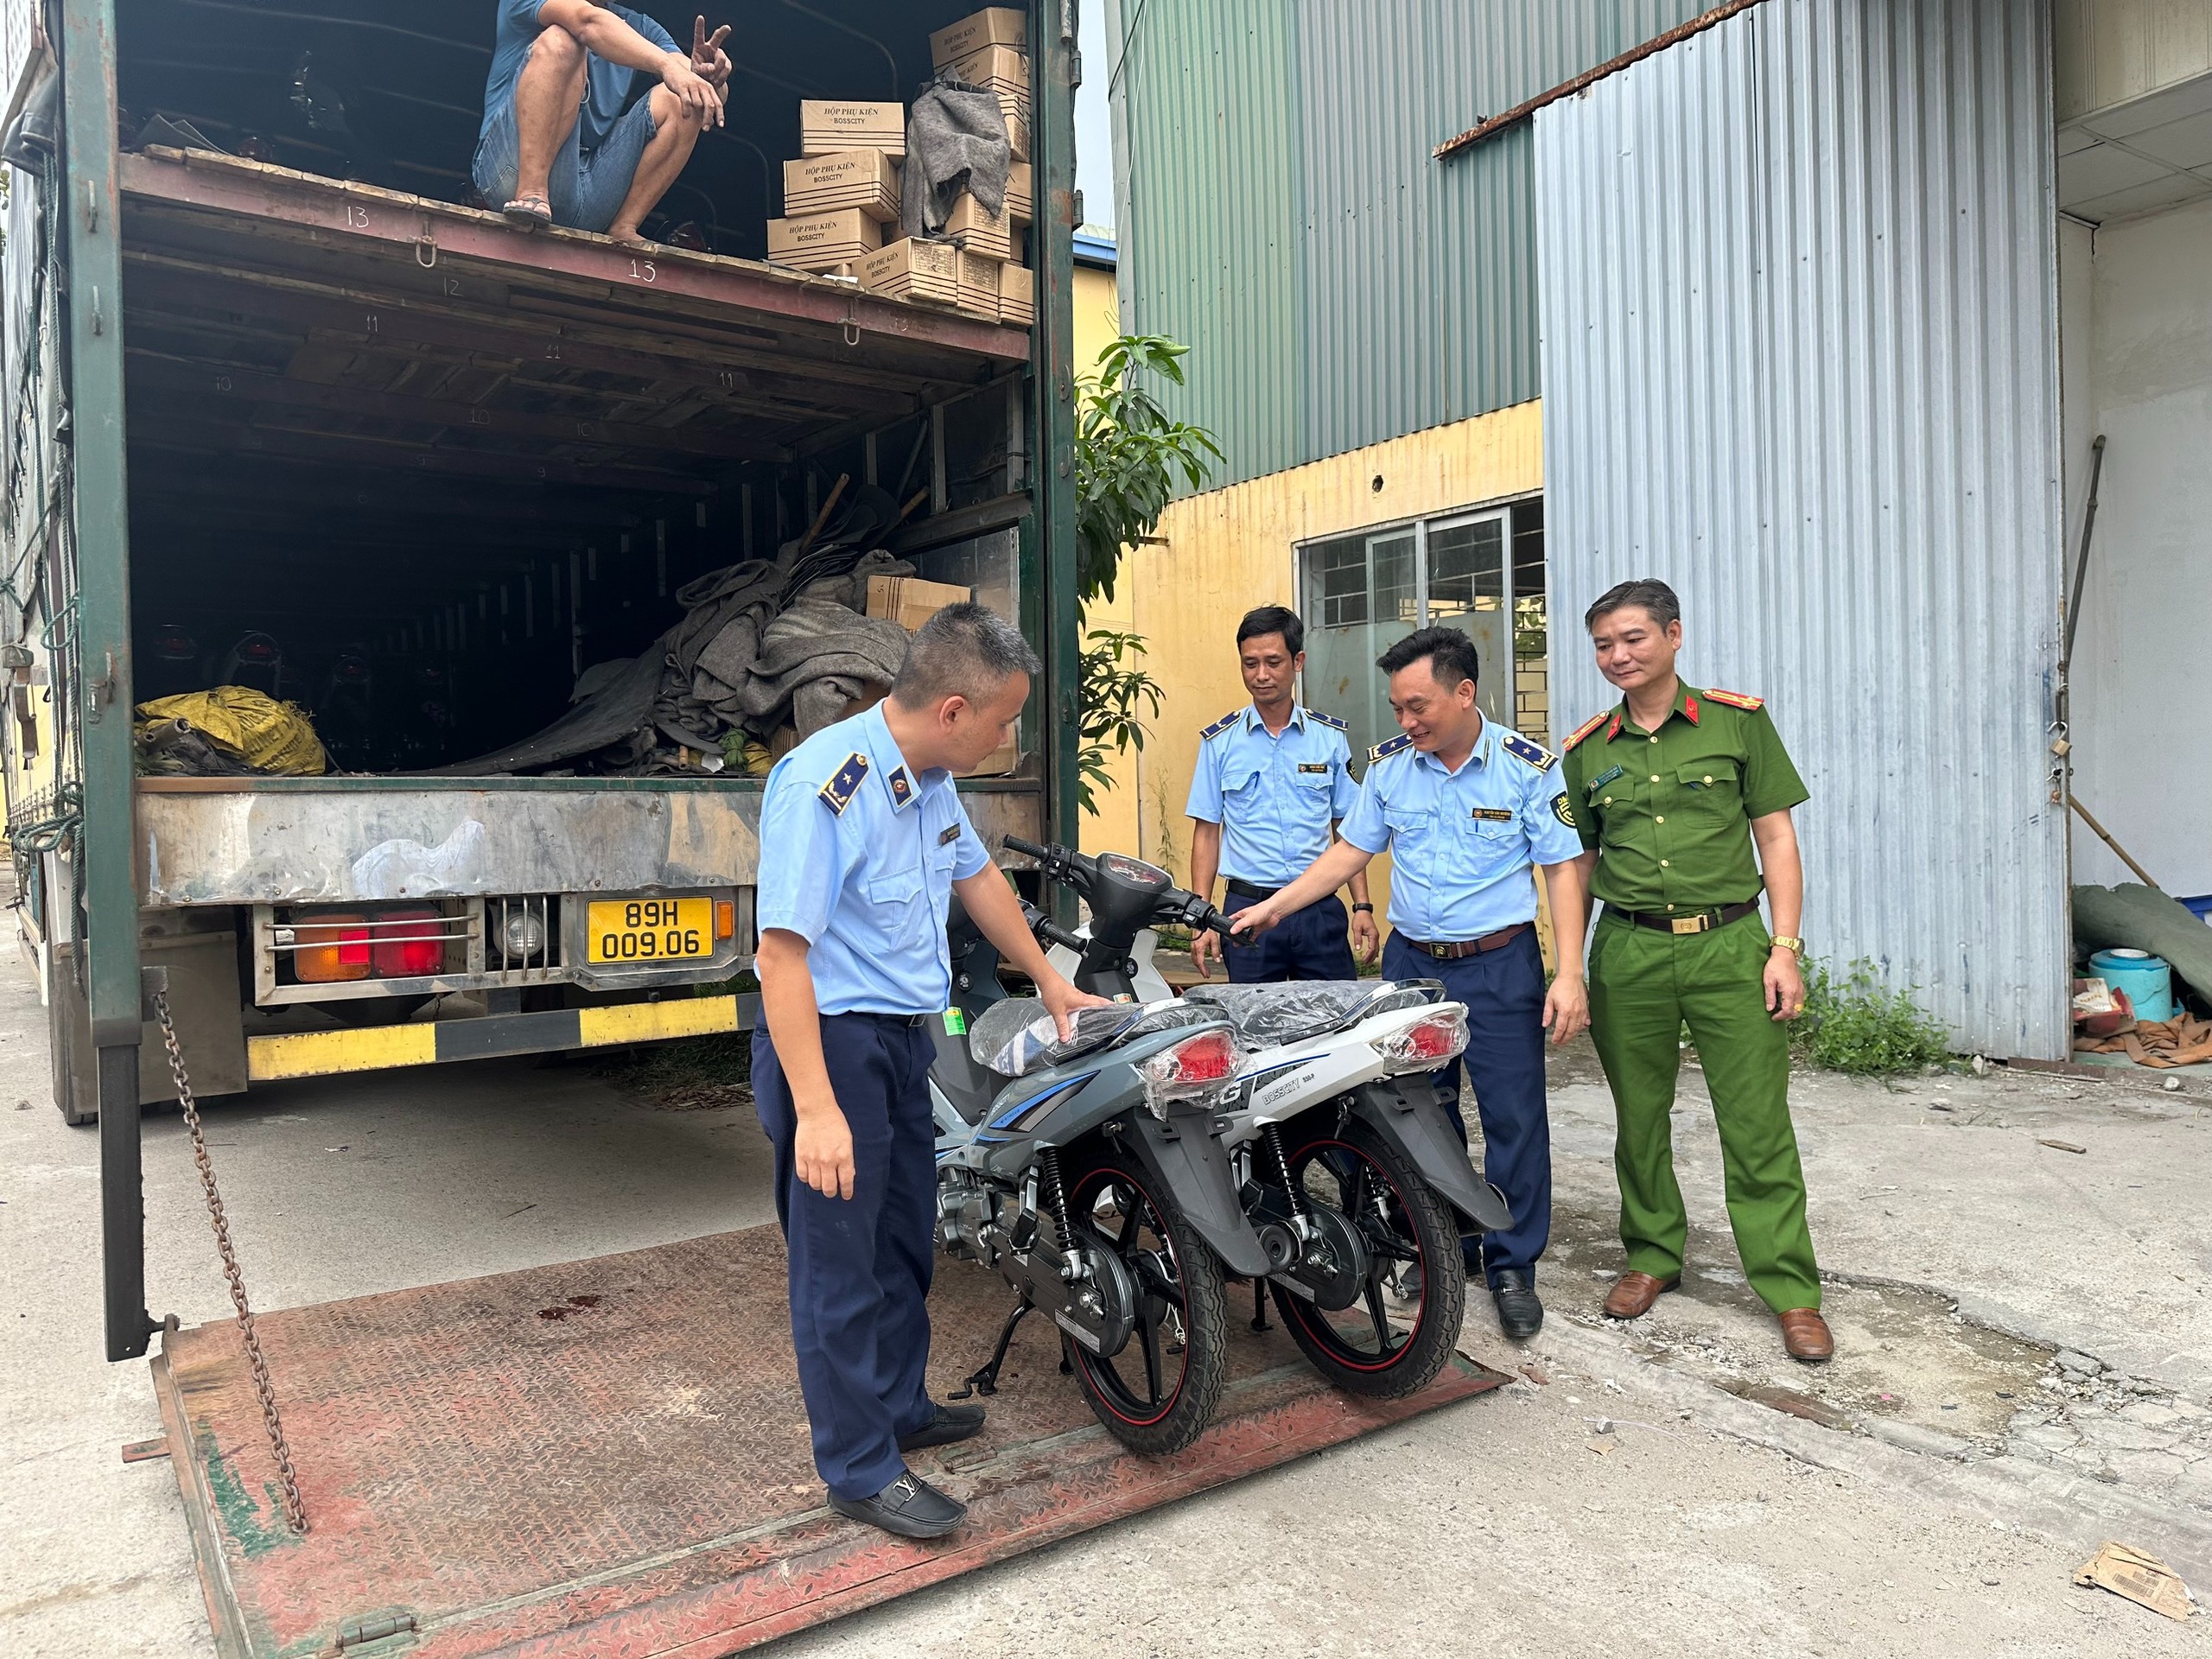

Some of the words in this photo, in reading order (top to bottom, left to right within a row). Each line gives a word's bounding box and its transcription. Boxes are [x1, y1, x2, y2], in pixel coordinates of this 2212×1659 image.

[824, 106, 841, 116] HỘP
[859, 106, 879, 116] KIỆN
[805, 166, 820, 175] HỘP
[821, 164, 836, 175] PHỤ
[837, 162, 855, 172] KIỆN
[813, 173, 843, 183] BOSSCITY
[347, 207, 370, 228] 13
[789, 224, 804, 234] HỘP
[804, 222, 819, 232] PHỤ
[820, 220, 838, 231] KIỆN
[797, 232, 825, 242] BOSSCITY
[629, 259, 657, 283] 13
[871, 265, 891, 278] BOSSCITY
[443, 277, 465, 297] 12
[366, 315, 379, 334] 11
[545, 345, 562, 360] 11
[216, 377, 232, 392] 10
[719, 372, 734, 388] 11
[469, 408, 491, 425] 10
[576, 422, 594, 436] 10
[626, 901, 678, 928] 89H
[602, 930, 699, 958] 009.06
[1262, 1077, 1300, 1105] BOSSCITY
